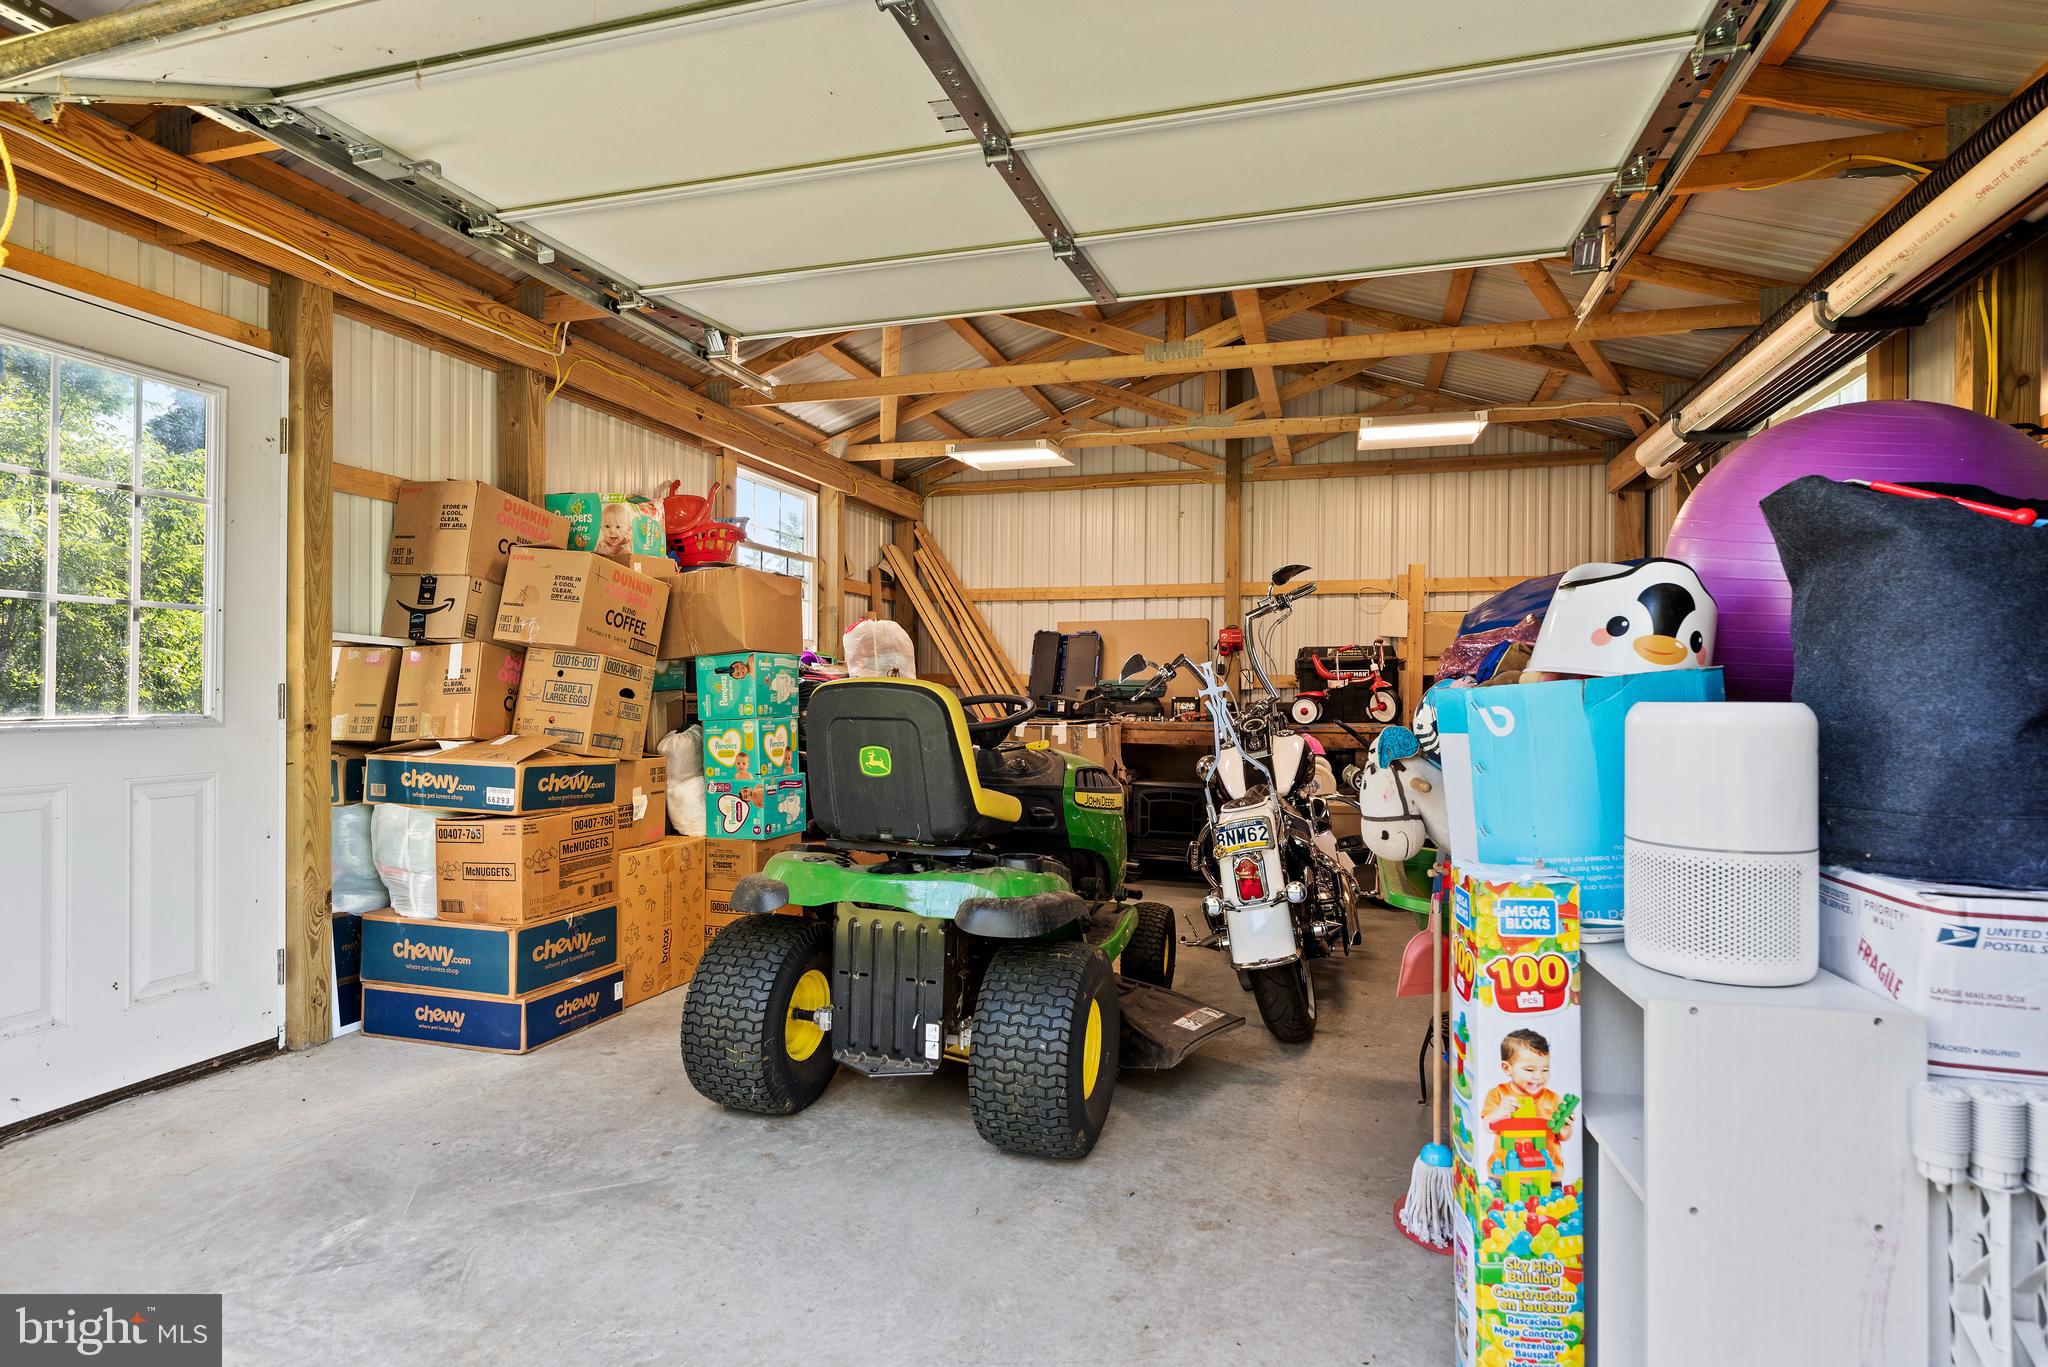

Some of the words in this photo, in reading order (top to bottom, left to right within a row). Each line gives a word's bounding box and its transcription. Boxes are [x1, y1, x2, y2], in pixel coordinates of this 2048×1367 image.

[1975, 170, 2010, 200] CHARLOTTE
[554, 574, 574, 582] STORE
[500, 614, 513, 623] FIRST
[622, 606, 636, 616] BLEND
[498, 623, 512, 632] FIRST
[605, 609, 647, 636] COFFEE
[555, 654, 597, 668] 00016-001
[606, 661, 641, 678] 00016-001
[553, 682, 577, 694] GRADE
[578, 685, 583, 694] A
[719, 675, 728, 706] Pampers
[545, 692, 568, 703] LARGE
[569, 694, 588, 705] EGGS
[395, 716, 409, 724] FIRST
[394, 725, 408, 733] FIRST
[714, 741, 738, 750] Pampers
[400, 769, 475, 793] chewy.com
[537, 773, 605, 793] chewy.com
[574, 816, 613, 831] 00407-756
[1585, 855, 1610, 863] based
[1505, 905, 1549, 917] MEGA
[1864, 899, 1905, 920] PRIORITY
[1505, 918, 1550, 930] BLOKS
[1872, 916, 1894, 930] MAIL
[1986, 927, 2042, 939] UNITED
[392, 938, 471, 967] chewy.com
[532, 932, 607, 962] chewy.com
[661, 928, 670, 965] britax
[1982, 941, 2036, 954] POSTAL
[544, 961, 561, 970] where
[561, 958, 569, 966] pet
[569, 954, 583, 962] lovers
[583, 950, 596, 959] shop
[1453, 937, 1474, 984] 100
[1489, 955, 1568, 989] 100
[1857, 936, 1904, 1001] FRAGILE
[1930, 987, 1962, 998] LARGE
[1965, 991, 2003, 1001] MAILING
[2005, 994, 2025, 1003] BOX
[555, 991, 600, 1018] chewy
[415, 1004, 465, 1028] chewy
[1927, 1042, 1971, 1053] TRACKED
[1980, 1048, 2021, 1058] INSURED
[1506, 1259, 1529, 1273] Sky
[1532, 1260, 1562, 1275] High
[1510, 1272, 1560, 1288] Building
[1493, 1286, 1575, 1303] Construction
[1500, 1301, 1517, 1311] en
[1519, 1300, 1569, 1313] hauteur
[1508, 1316, 1561, 1327] Rascacielos
[1494, 1326, 1520, 1337] Mega
[1522, 1329, 1575, 1341] Construção
[1503, 1340, 1565, 1352] Grenzenloser
[1515, 1350, 1555, 1360] Bauspaß
